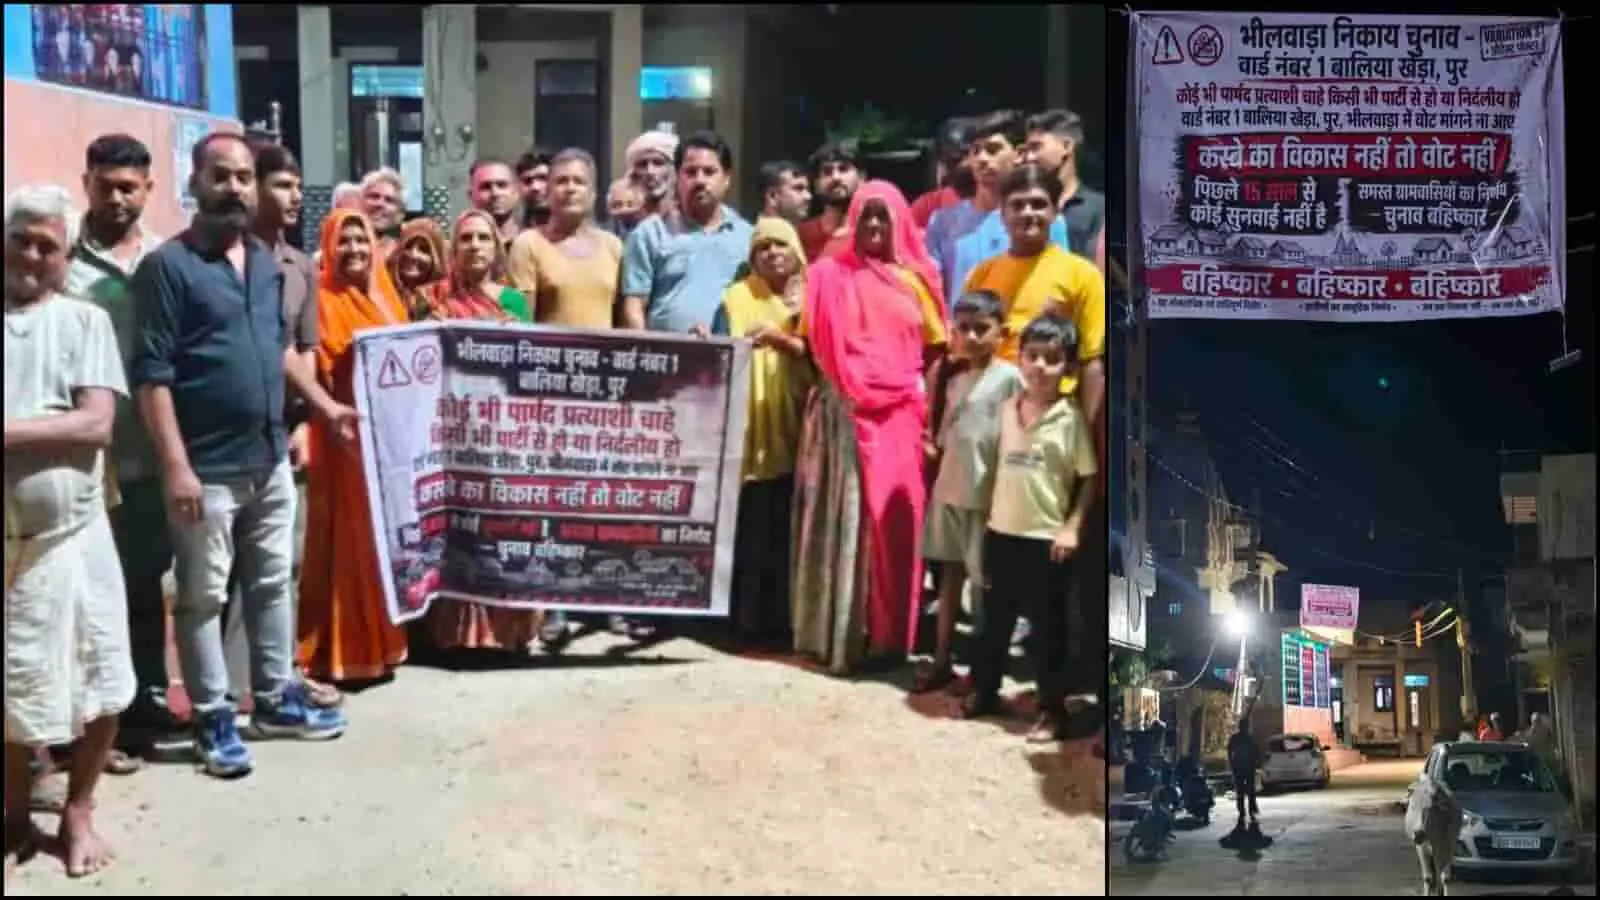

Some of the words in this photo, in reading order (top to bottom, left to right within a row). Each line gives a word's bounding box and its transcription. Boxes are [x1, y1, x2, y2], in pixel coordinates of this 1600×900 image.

[1240, 16, 1327, 55] भीलवाड़ा
[1333, 16, 1400, 49] निकाय
[1405, 25, 1461, 57] चुनाव
[1238, 51, 1270, 76] वार्ड
[1275, 52, 1312, 77] नंबर
[1317, 55, 1325, 77] 1
[1331, 51, 1394, 77] बालिया
[1446, 59, 1469, 86] पुर
[1176, 82, 1200, 106] कोई
[1203, 81, 1217, 104] भी
[1302, 85, 1324, 106] चाहे
[1328, 85, 1360, 106] किसी
[1364, 85, 1379, 105] भी
[1410, 86, 1421, 106] से
[1423, 86, 1437, 108] हो
[1440, 91, 1455, 106] या
[1508, 85, 1521, 109] हो
[1233, 108, 1240, 127] 1
[1242, 105, 1287, 127] बालिया
[1415, 107, 1436, 128] वोट
[1198, 137, 1244, 170] कस्बे
[1249, 144, 1277, 169] का
[1281, 136, 1348, 169] विकास
[1353, 136, 1391, 171] नहीं
[1394, 136, 1417, 169] तो
[1421, 136, 1457, 169] वोट
[1461, 137, 1498, 172] नहीं
[1194, 175, 1240, 200] पिछले
[1302, 176, 1316, 200] से
[1358, 183, 1393, 199] समस्त
[1459, 186, 1475, 200] का
[1189, 200, 1222, 226] कोई
[1226, 203, 1280, 232] सुनवाई
[1283, 201, 1313, 229] नहीं
[1315, 200, 1328, 229] है
[1384, 205, 1424, 231] चुनाव
[1427, 201, 1487, 228] बहिष्कार
[1182, 265, 1274, 297] बहिष्कार
[1296, 268, 1388, 298] बहिष्कार
[1409, 270, 1503, 299] बहिष्कार
[437, 393, 471, 423] कोई
[478, 395, 501, 422] भी
[563, 401, 632, 429] प्रत्याशी
[640, 406, 675, 433] चाहे
[472, 423, 491, 447] भी
[664, 435, 682, 457] हो
[461, 480, 485, 501] का
[490, 477, 548, 505] विकास
[555, 481, 588, 507] नहीं
[615, 481, 645, 507] वोट
[650, 484, 684, 512] नहीं
